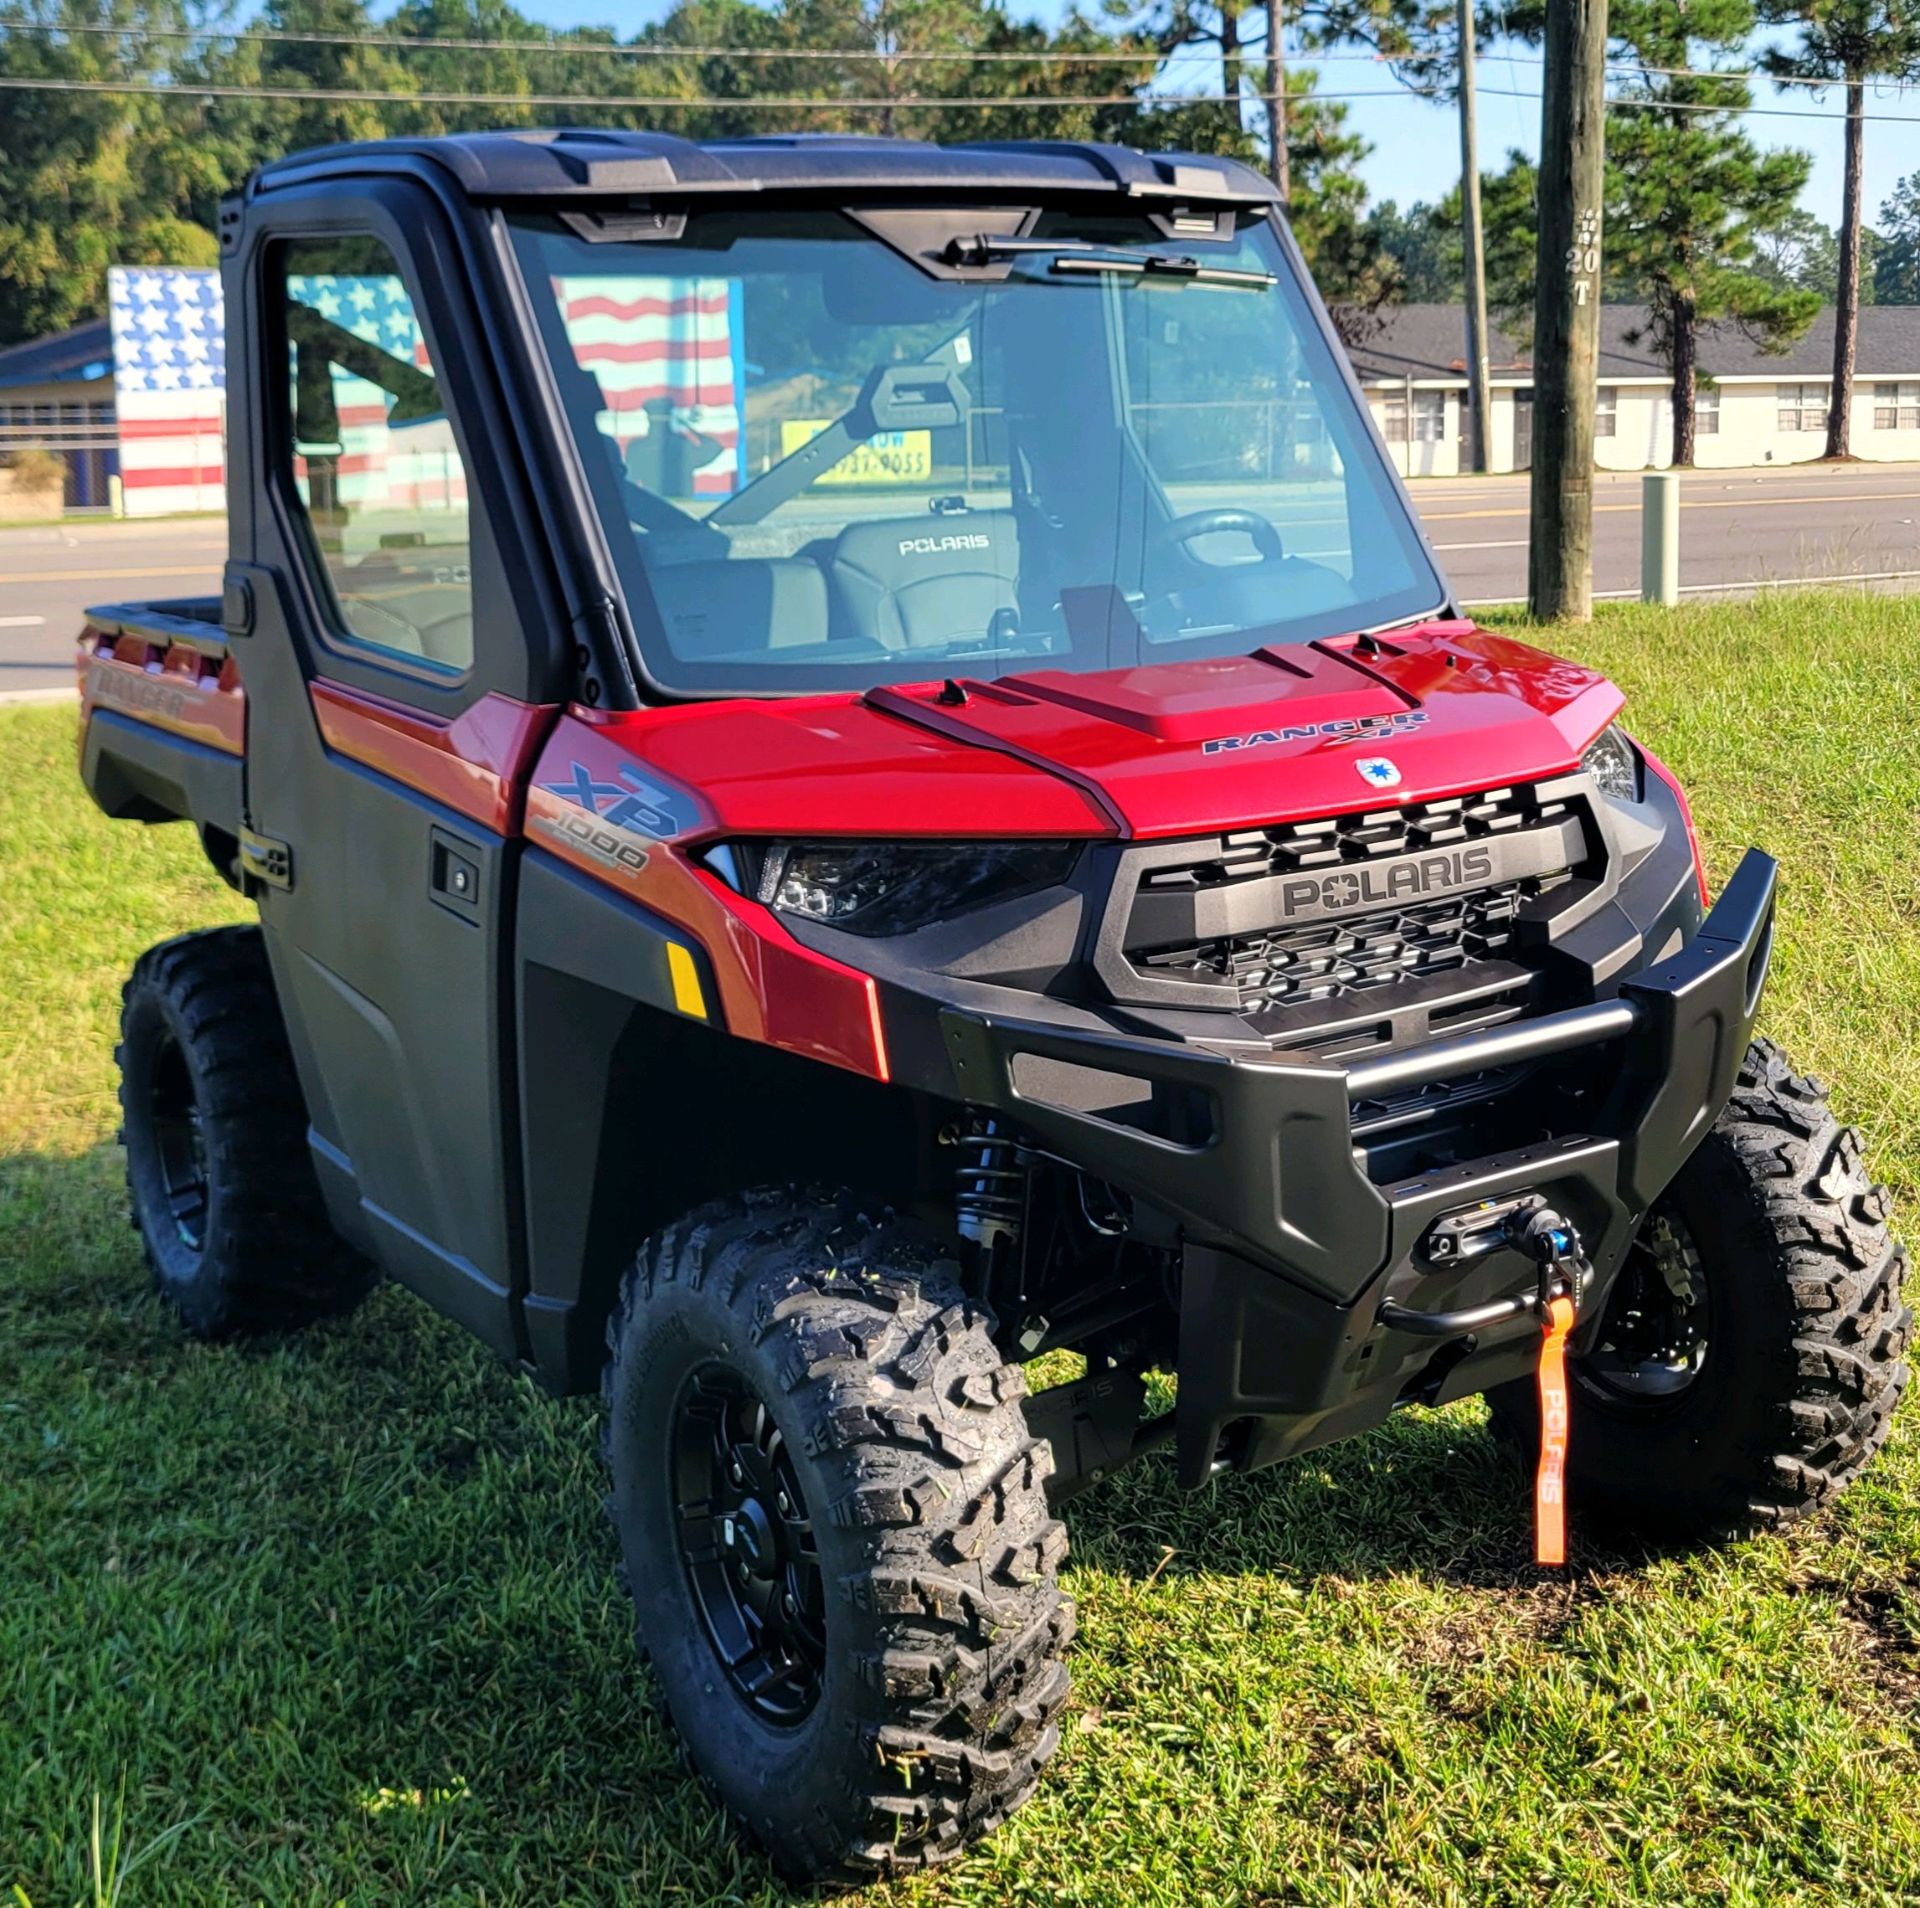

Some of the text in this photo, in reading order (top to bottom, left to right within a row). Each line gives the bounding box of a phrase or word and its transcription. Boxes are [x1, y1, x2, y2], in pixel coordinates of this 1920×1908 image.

[1565, 248, 1600, 273] 20
[1574, 281, 1590, 305] T
[898, 534, 990, 556] POLARIS
[1202, 711, 1432, 756] RANGER
[1324, 725, 1421, 747] XP
[541, 760, 679, 841] XP
[558, 811, 650, 871] 1000
[1283, 846, 1492, 917] POLARIS
